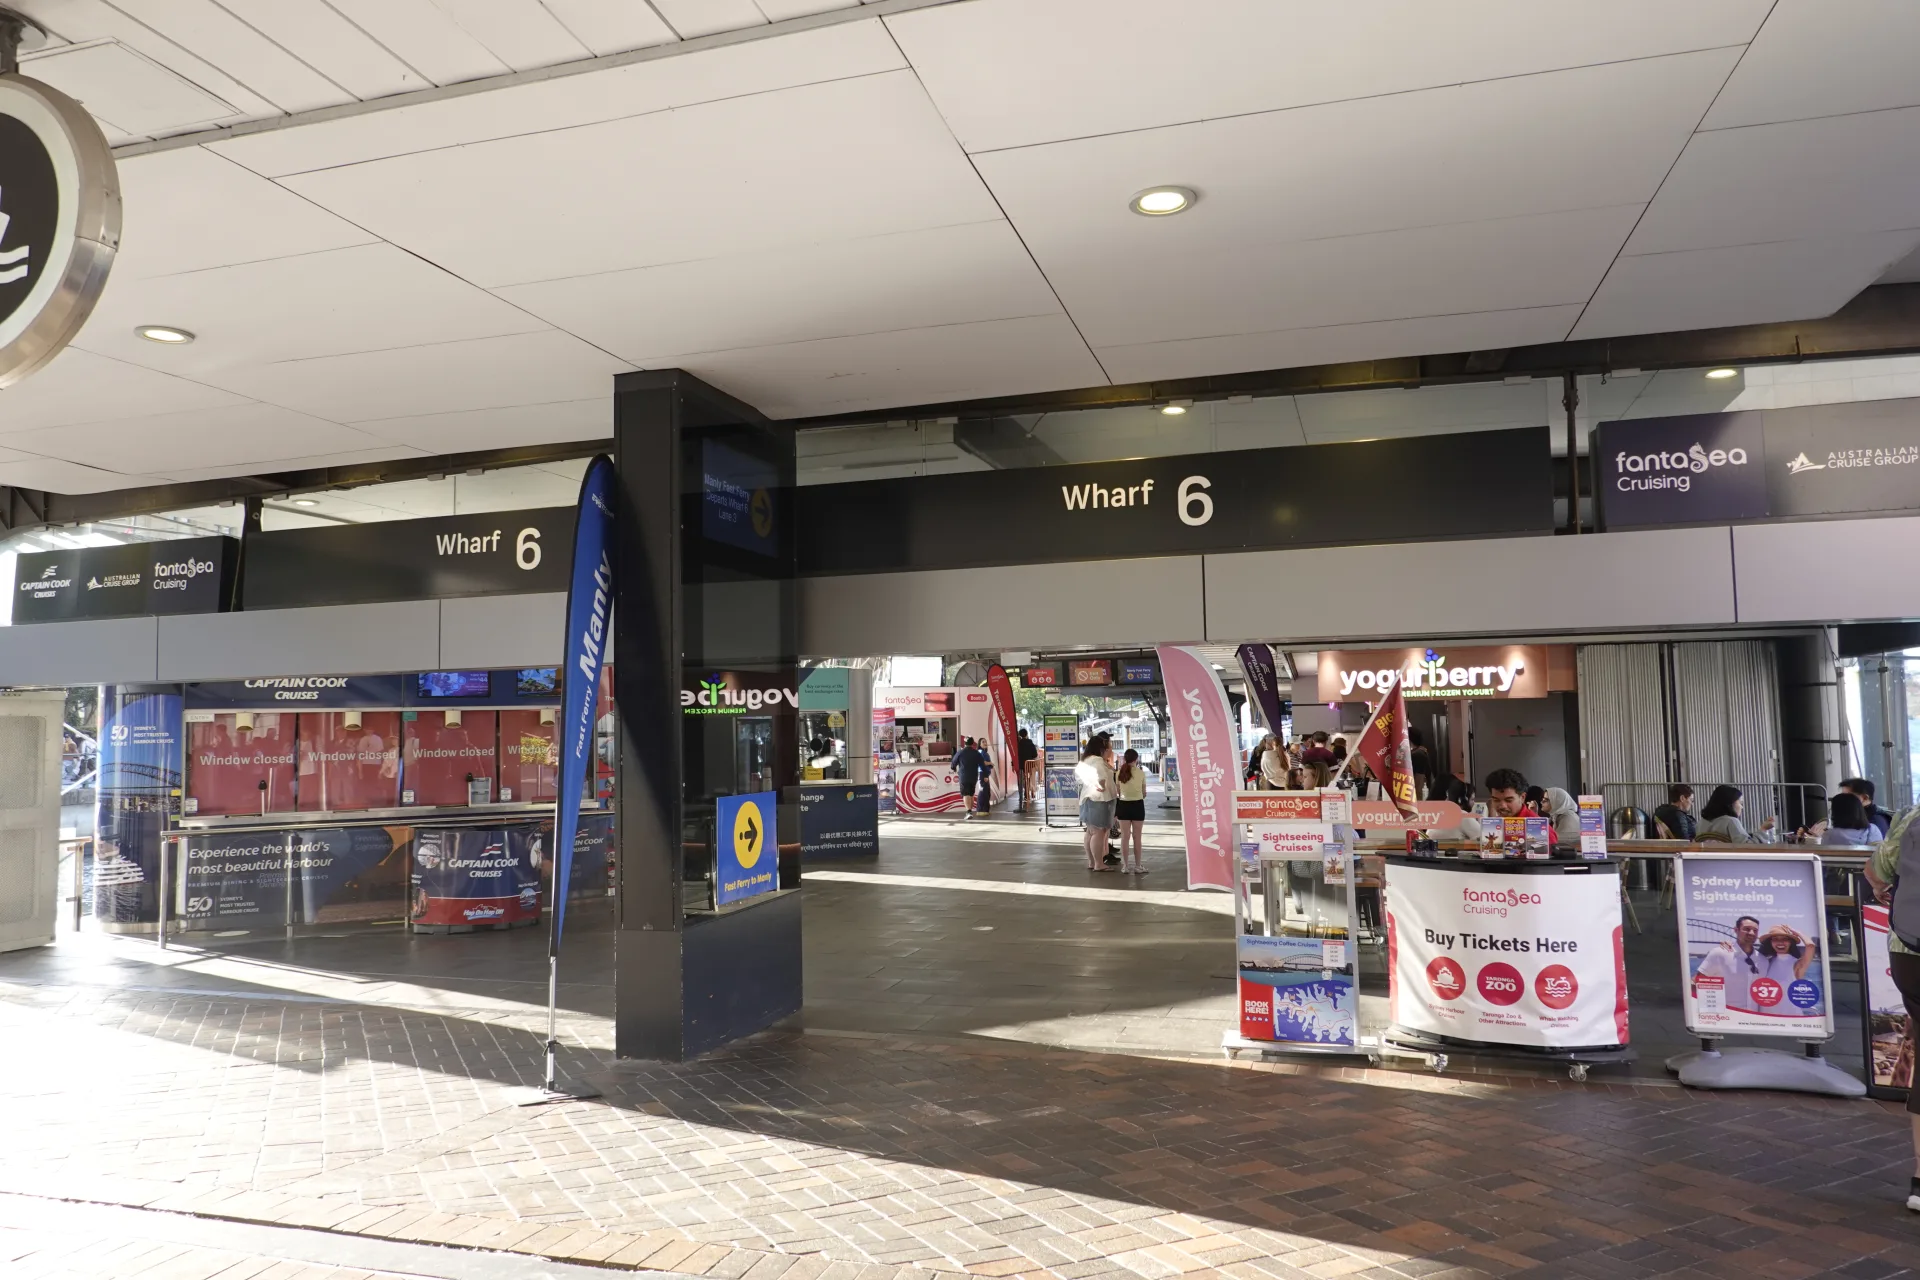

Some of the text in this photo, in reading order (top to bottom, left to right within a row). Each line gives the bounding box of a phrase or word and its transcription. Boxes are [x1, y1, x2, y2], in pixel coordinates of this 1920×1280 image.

[1827, 446, 1919, 460] AUSTRALIAN
[1827, 454, 1919, 470] CRUISE GROUP
[1617, 474, 1691, 492] Cruising
[1062, 475, 1214, 527] Wharf 6
[718, 509, 732, 521] Lane
[436, 527, 542, 570] Wharf 6
[103, 573, 141, 582] AUSTRALIAN
[103, 578, 141, 588] CRUISE GROUP
[20, 578, 72, 591] CAPTAIN COOK
[153, 578, 187, 591] Cruising
[33, 590, 57, 599] CRUISES
[579, 548, 613, 682] Manly
[1246, 646, 1269, 692] CAPTAIN COOK
[307, 677, 348, 688] COOK
[1339, 661, 1519, 696] yogurberry
[274, 691, 319, 700] CRUISES
[1431, 689, 1461, 698] FROZEN
[1462, 687, 1494, 697] YOGURT
[993, 688, 1011, 735] Taronga Zoo
[575, 727, 587, 759] Fast
[308, 749, 397, 762] Window closed
[412, 746, 495, 759] Window closed
[199, 753, 295, 766] Window closed
[1182, 688, 1225, 851] yogurberry
[1393, 771, 1407, 782] BUY
[1265, 809, 1296, 819] Cruising
[584, 837, 604, 846] COOK
[1262, 832, 1324, 843] Sightseeing
[189, 841, 330, 860] Experience the world's
[1274, 843, 1314, 852] Cruises
[188, 857, 334, 875] most beautiful Harbour
[448, 857, 519, 869] CAPTAIN COOK
[469, 870, 503, 878] CRUISES
[724, 871, 772, 892] Fast Ferry to Manly
[1691, 875, 1802, 890] Sydney Harbour
[187, 896, 213, 912] 50
[1692, 890, 1774, 905] Sightseeing
[1463, 903, 1507, 918] Cruising
[1246, 938, 1278, 947] Sightseeing
[1424, 929, 1578, 953] Buy Tickets Here
[1485, 981, 1517, 992] ZOO
[1752, 986, 1779, 998] $37
[1244, 1000, 1269, 1008] BOOK
[1244, 1007, 1269, 1015] HERE!
[1445, 1007, 1465, 1015] Harbour
[1482, 1011, 1505, 1020] Taronga
[1495, 1019, 1527, 1027] Attractions
